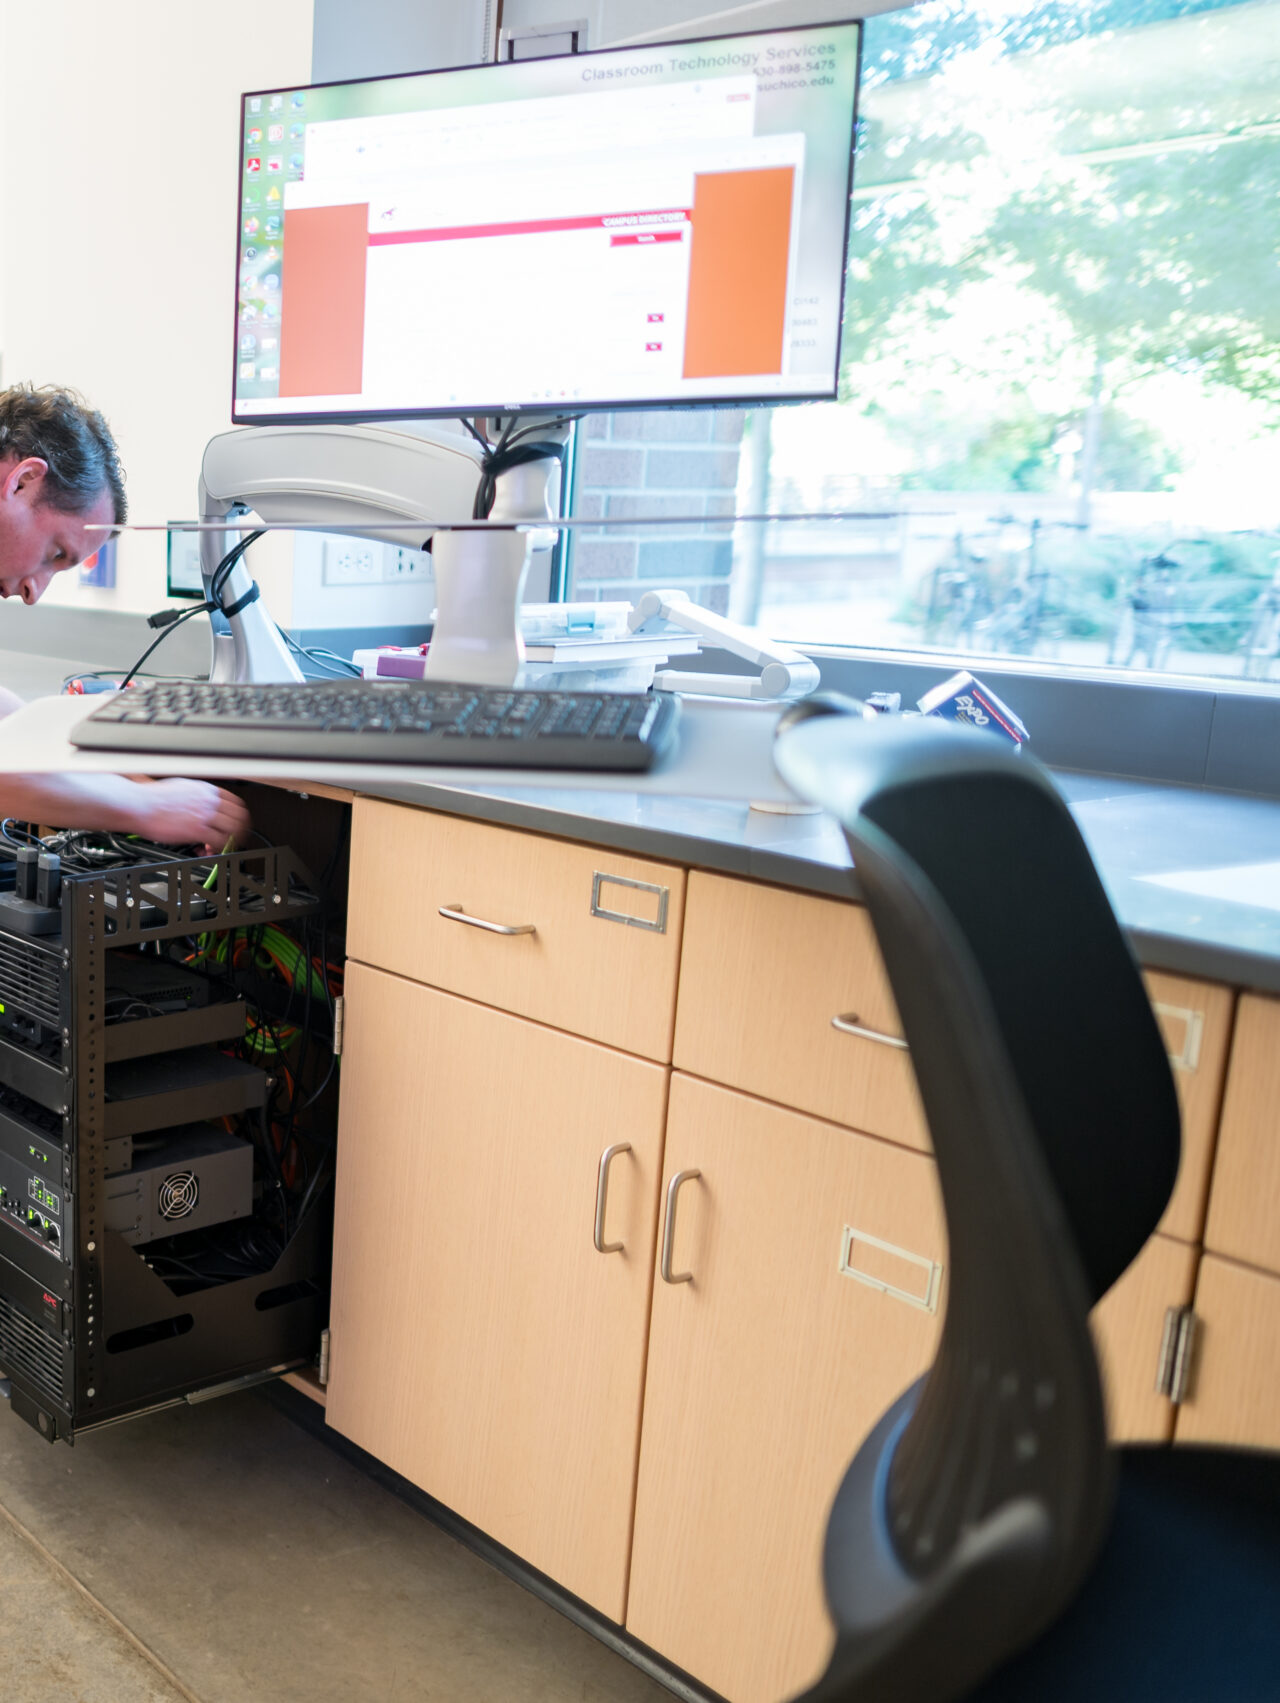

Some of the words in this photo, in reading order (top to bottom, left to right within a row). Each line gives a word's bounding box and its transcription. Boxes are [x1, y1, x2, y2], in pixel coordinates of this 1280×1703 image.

[581, 63, 663, 82] Classroom
[670, 53, 760, 72] Technology
[766, 43, 836, 61] Services
[602, 215, 638, 227] CAMPUS
[639, 211, 686, 225] DIRECTORY
[954, 695, 990, 726] EXPO
[42, 1292, 57, 1308] APC
